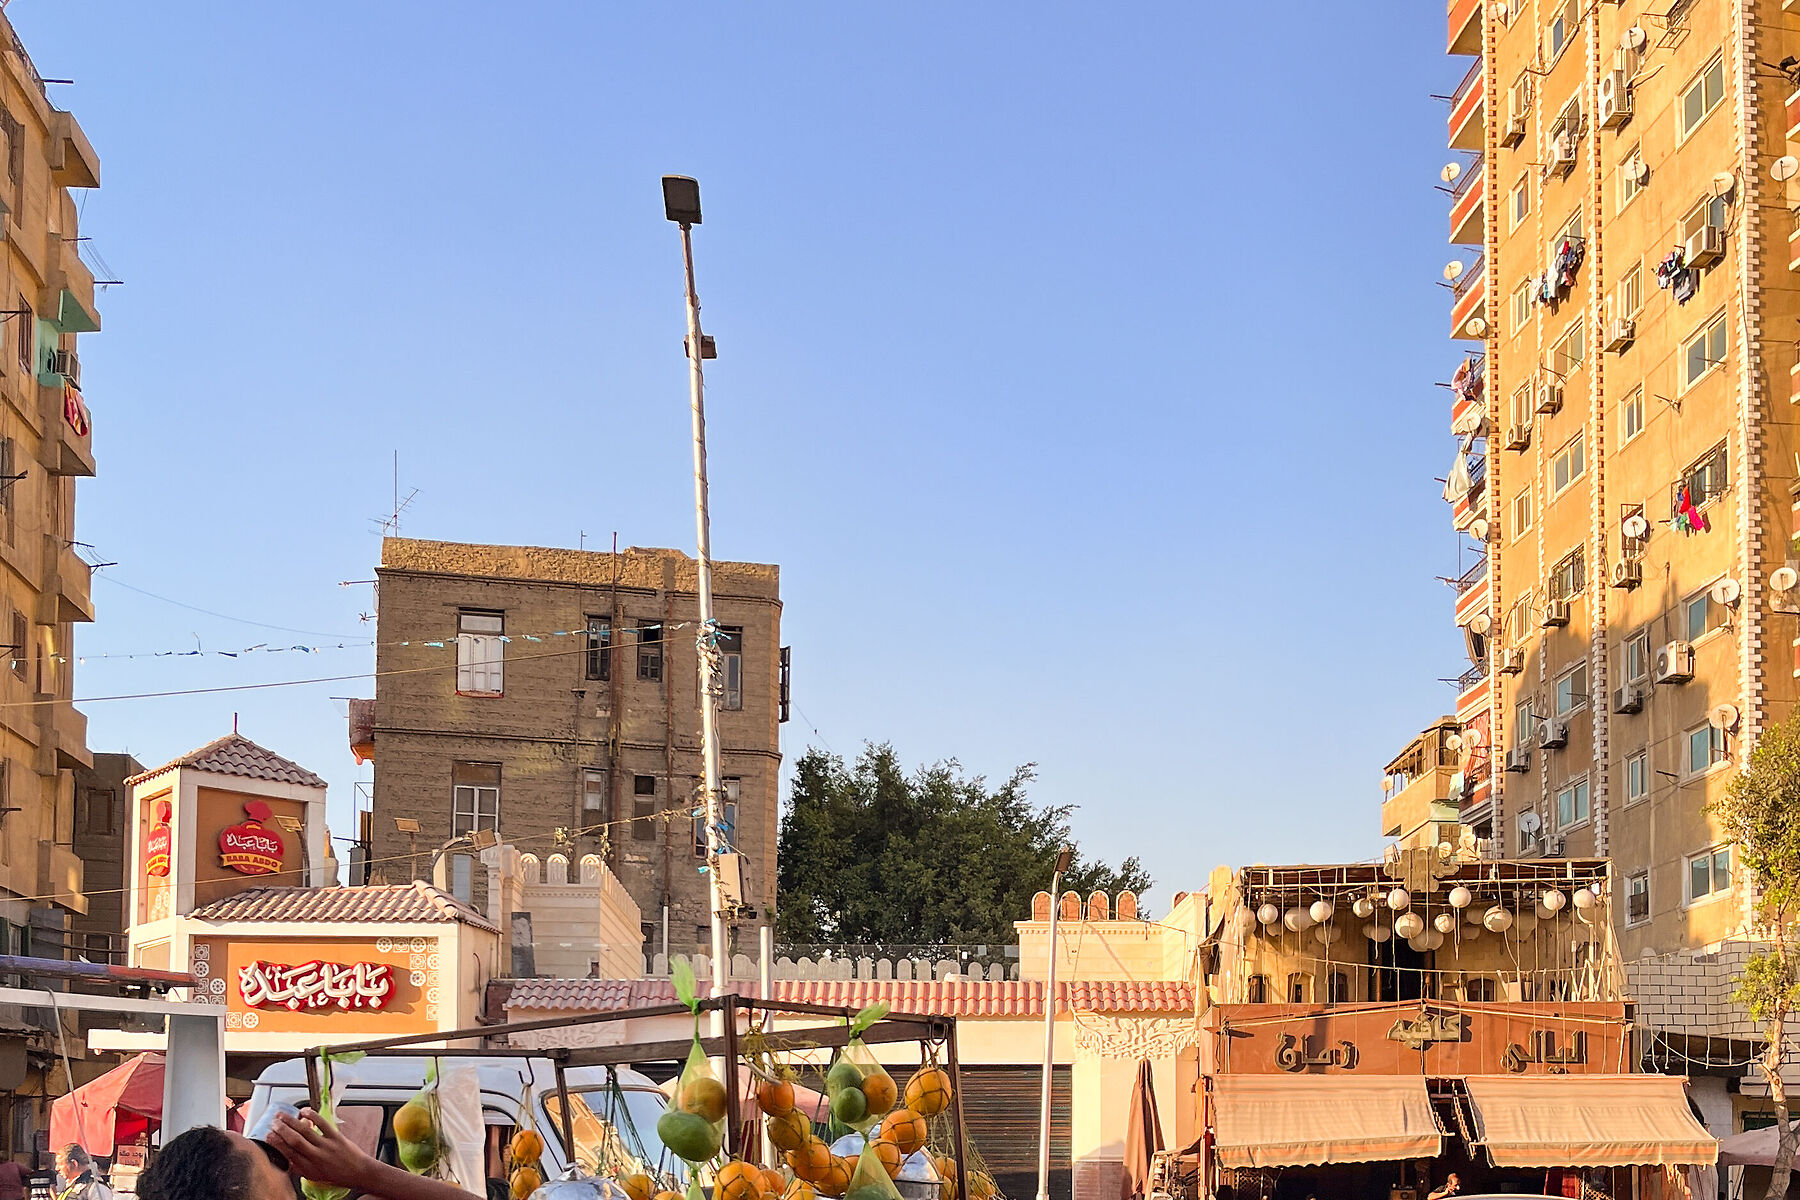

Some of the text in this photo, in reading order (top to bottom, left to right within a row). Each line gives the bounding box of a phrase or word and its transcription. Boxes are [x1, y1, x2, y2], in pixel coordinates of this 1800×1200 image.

[226, 855, 278, 867] BABA ABDO
[320, 962, 389, 1008] بابا
